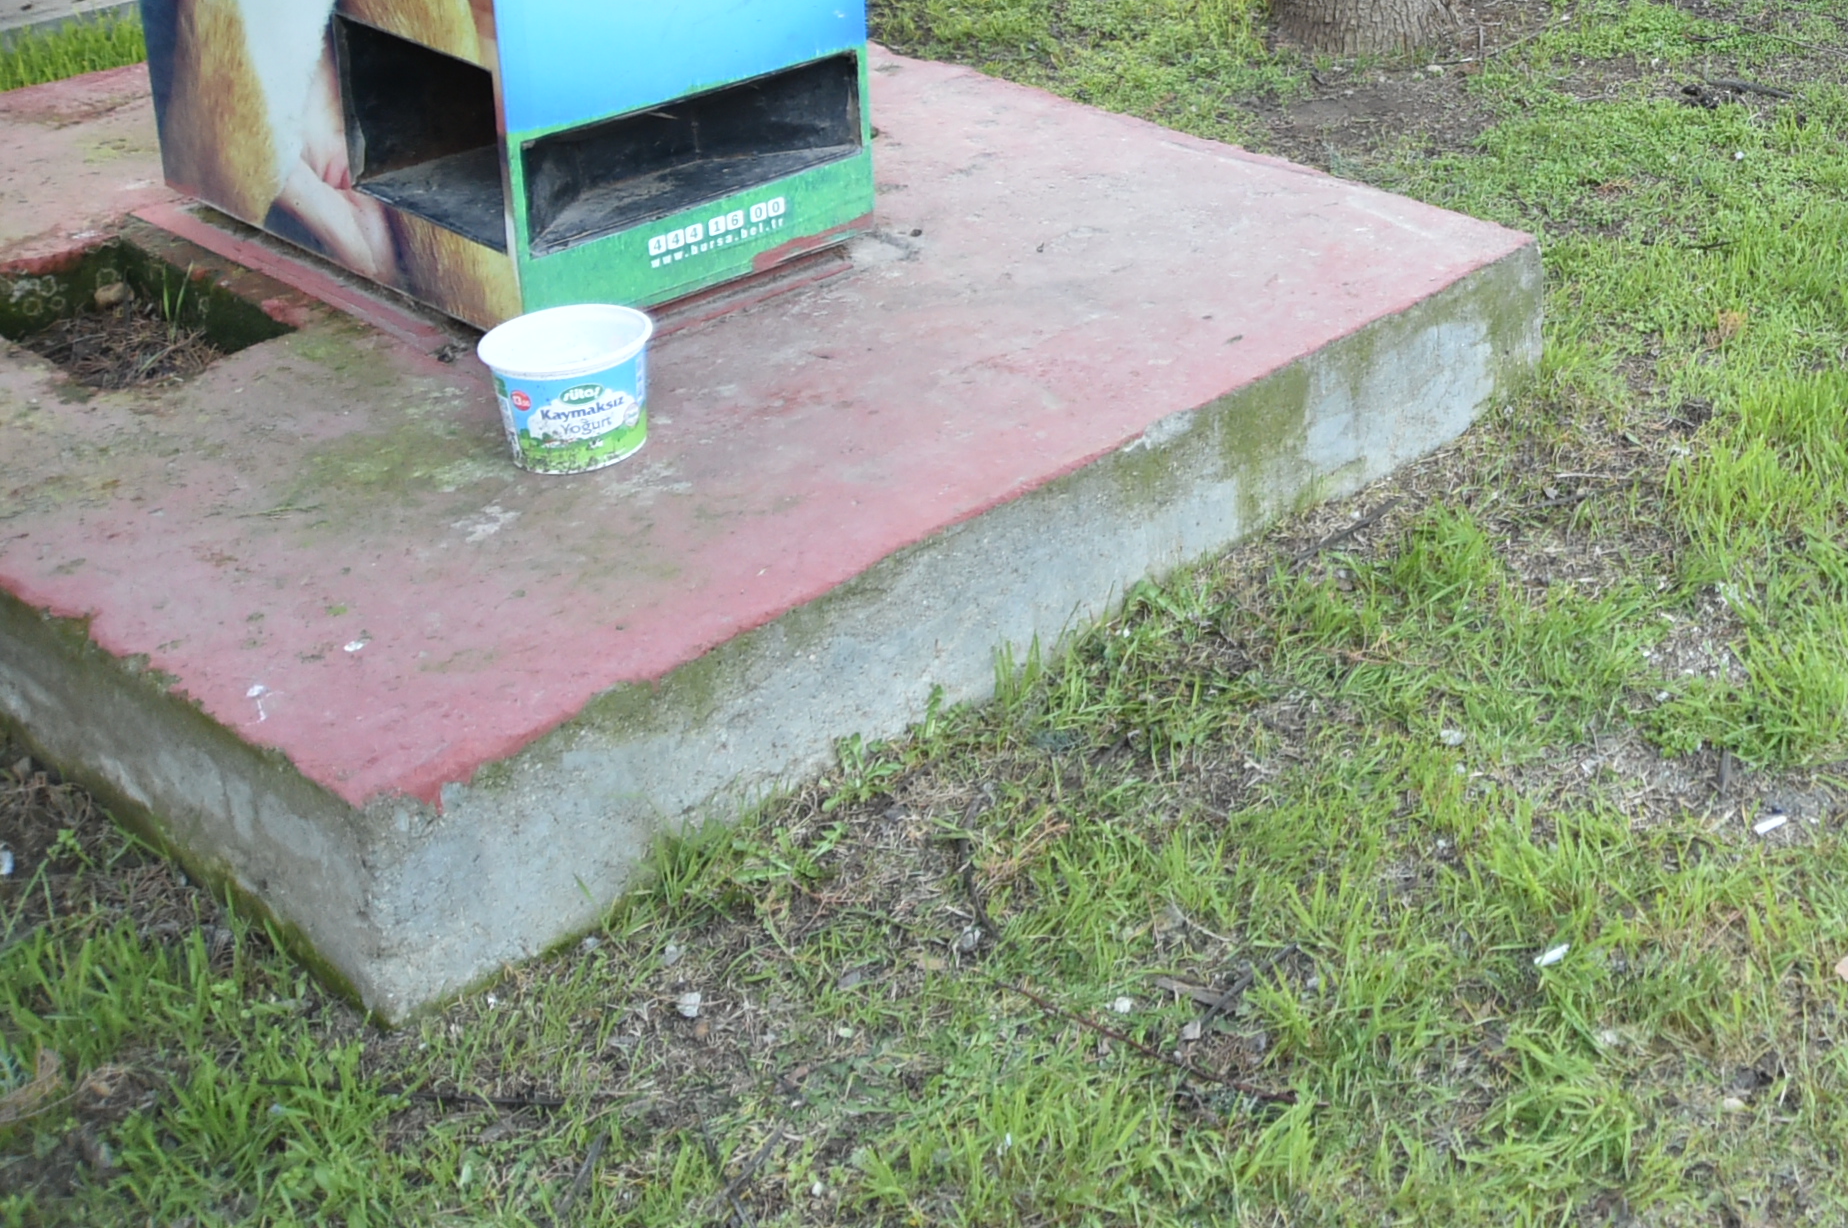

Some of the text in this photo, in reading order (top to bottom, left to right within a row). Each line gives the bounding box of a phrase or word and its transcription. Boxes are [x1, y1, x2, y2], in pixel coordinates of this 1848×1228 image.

[650, 225, 702, 254] 444
[710, 211, 742, 234] 16
[650, 218, 784, 269] www.bursa.bel.tr
[540, 396, 625, 422] Kaymaksız
[561, 416, 612, 436] Yoğurt
